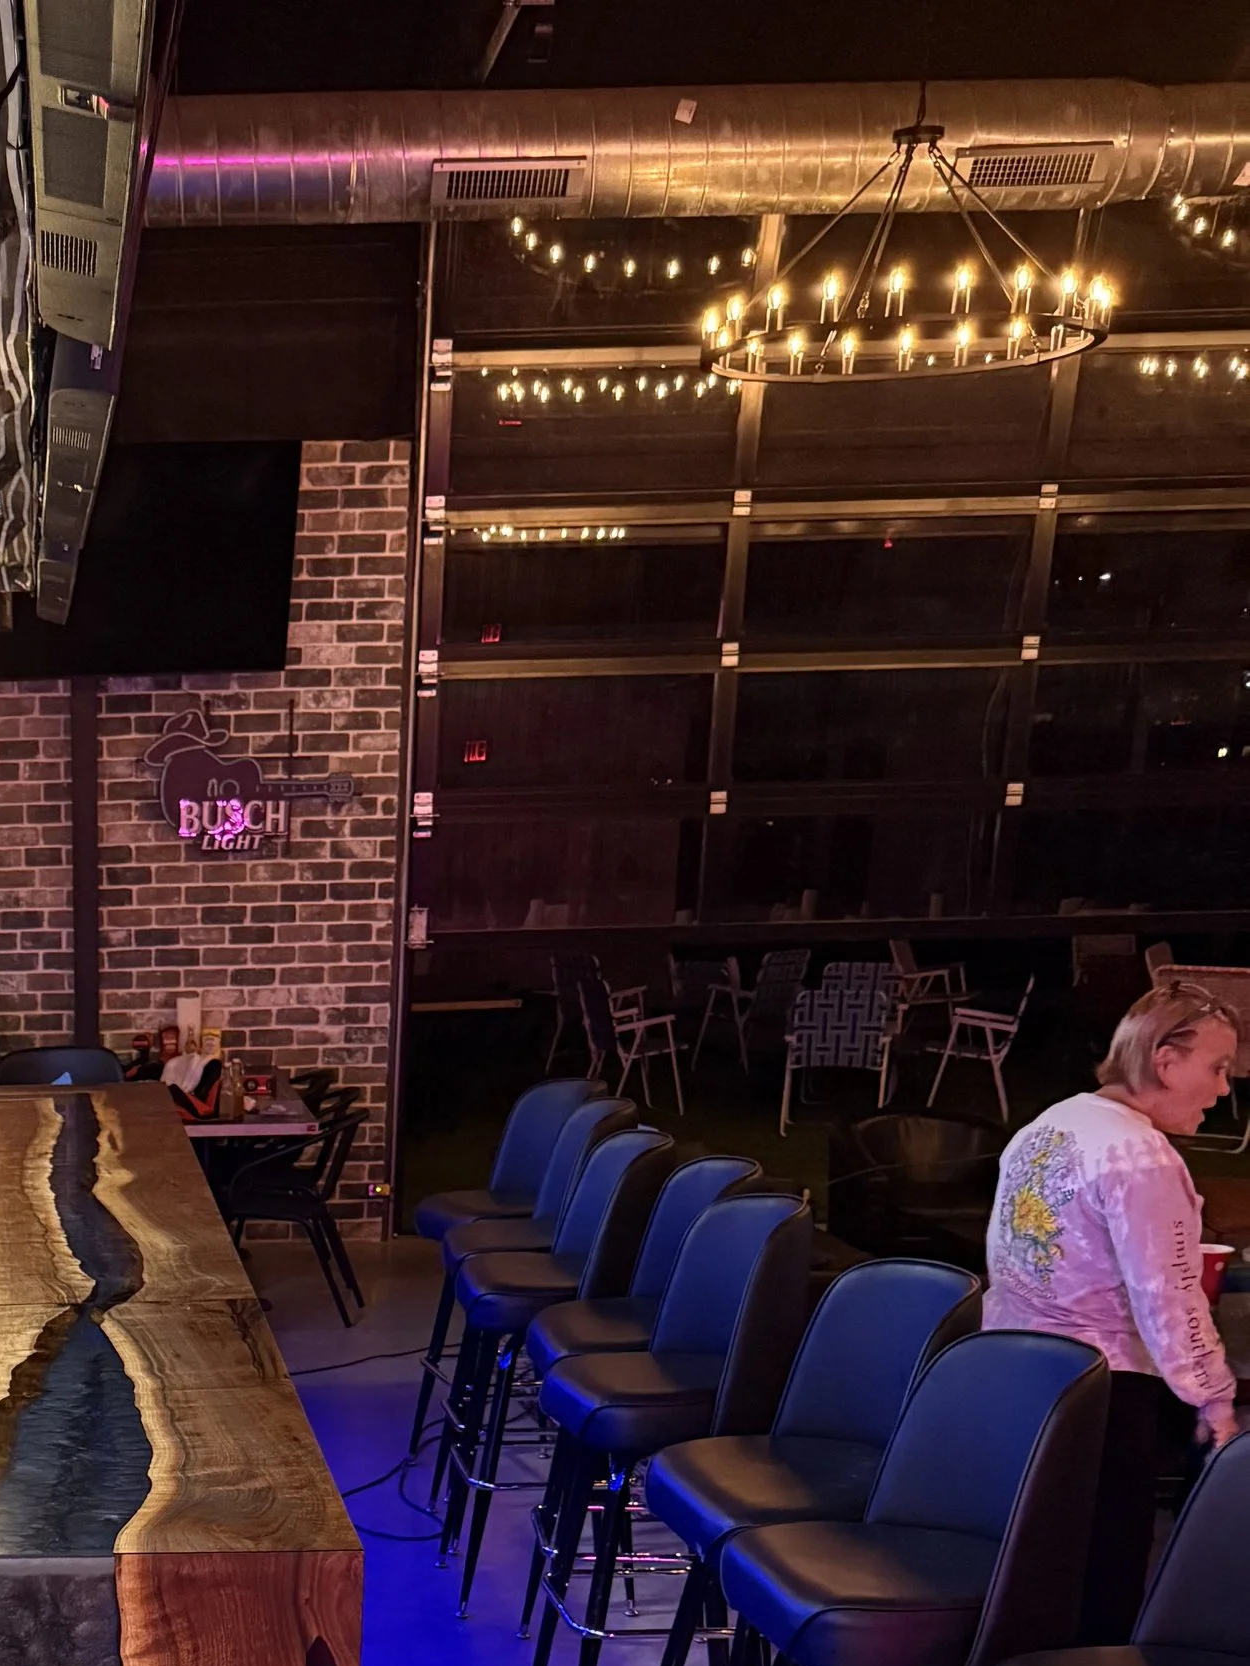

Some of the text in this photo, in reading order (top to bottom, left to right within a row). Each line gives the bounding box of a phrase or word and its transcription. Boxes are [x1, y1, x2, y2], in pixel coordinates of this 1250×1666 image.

[178, 799, 288, 837] BUSCH
[201, 834, 264, 850] LIGHT
[1172, 1220, 1198, 1293] simply
